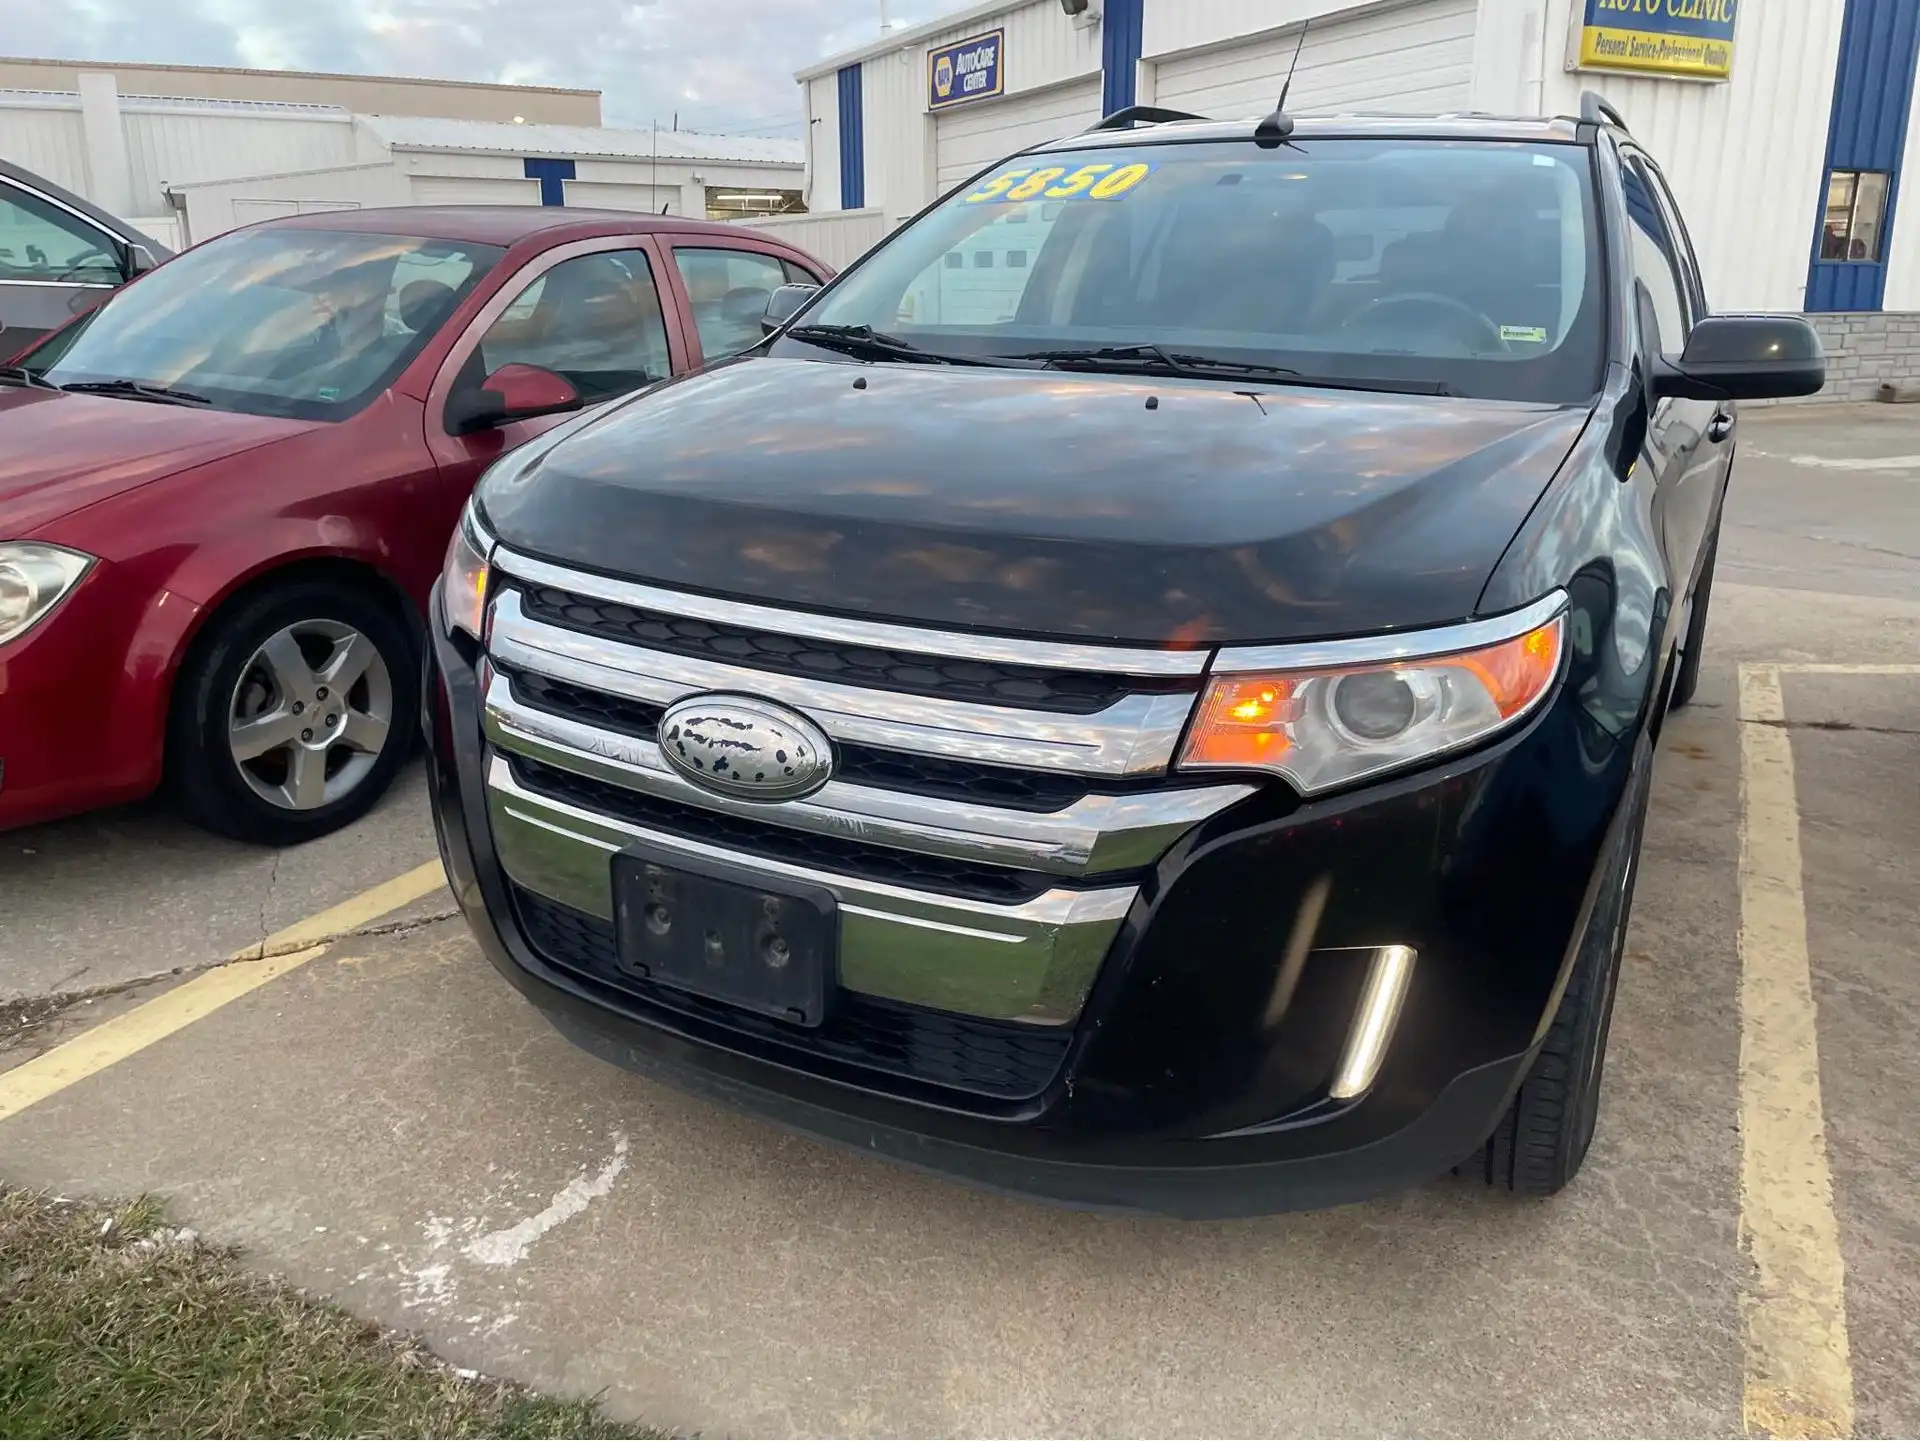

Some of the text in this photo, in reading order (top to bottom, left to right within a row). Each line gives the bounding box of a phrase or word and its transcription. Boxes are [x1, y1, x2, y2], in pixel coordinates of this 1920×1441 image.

[1667, 0, 1734, 23] CLINIC
[1594, 31, 1630, 57] Personal
[963, 70, 987, 92] CENTER
[966, 163, 1149, 204] 5850
